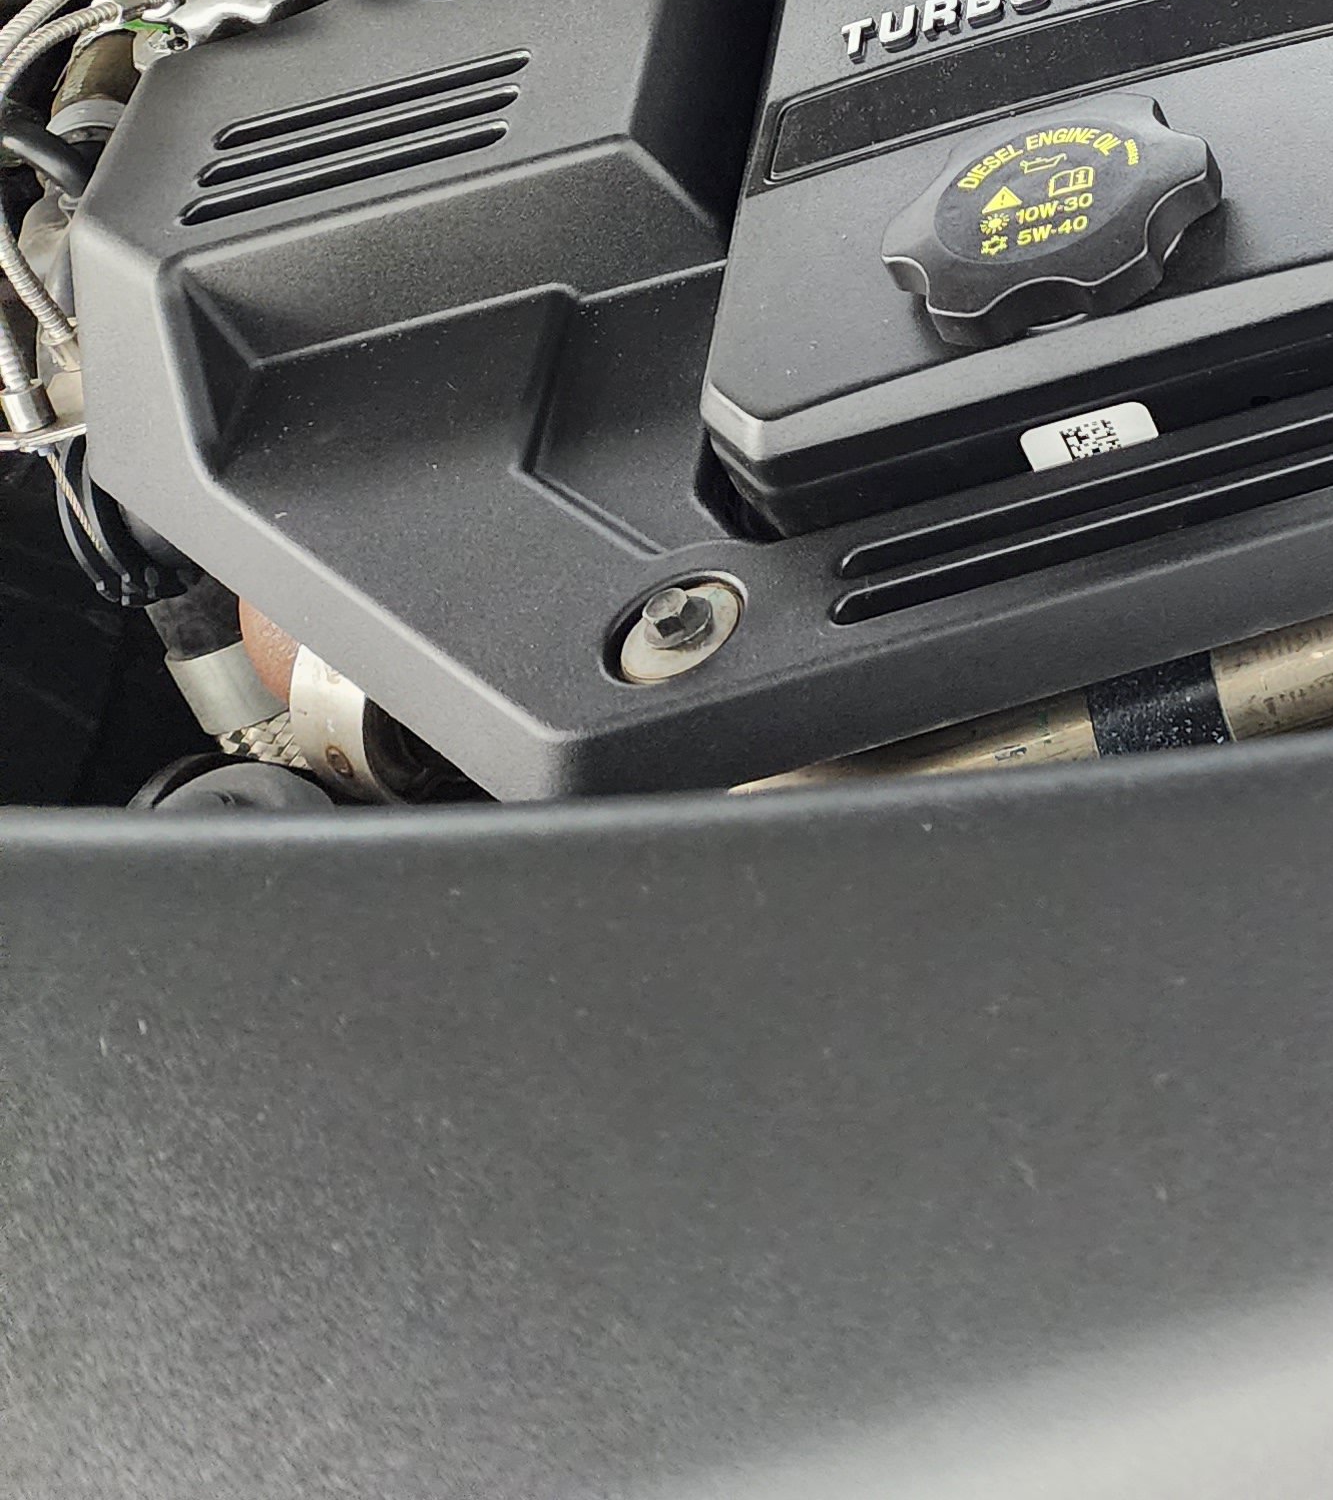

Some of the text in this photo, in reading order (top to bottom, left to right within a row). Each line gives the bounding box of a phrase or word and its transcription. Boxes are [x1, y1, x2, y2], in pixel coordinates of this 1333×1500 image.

[956, 143, 1026, 191] DIESEL
[1025, 126, 1101, 152] ENGINE
[1093, 131, 1122, 157] OIL
[1014, 192, 1095, 227] 10W-30
[1015, 215, 1090, 248] 5W-40
